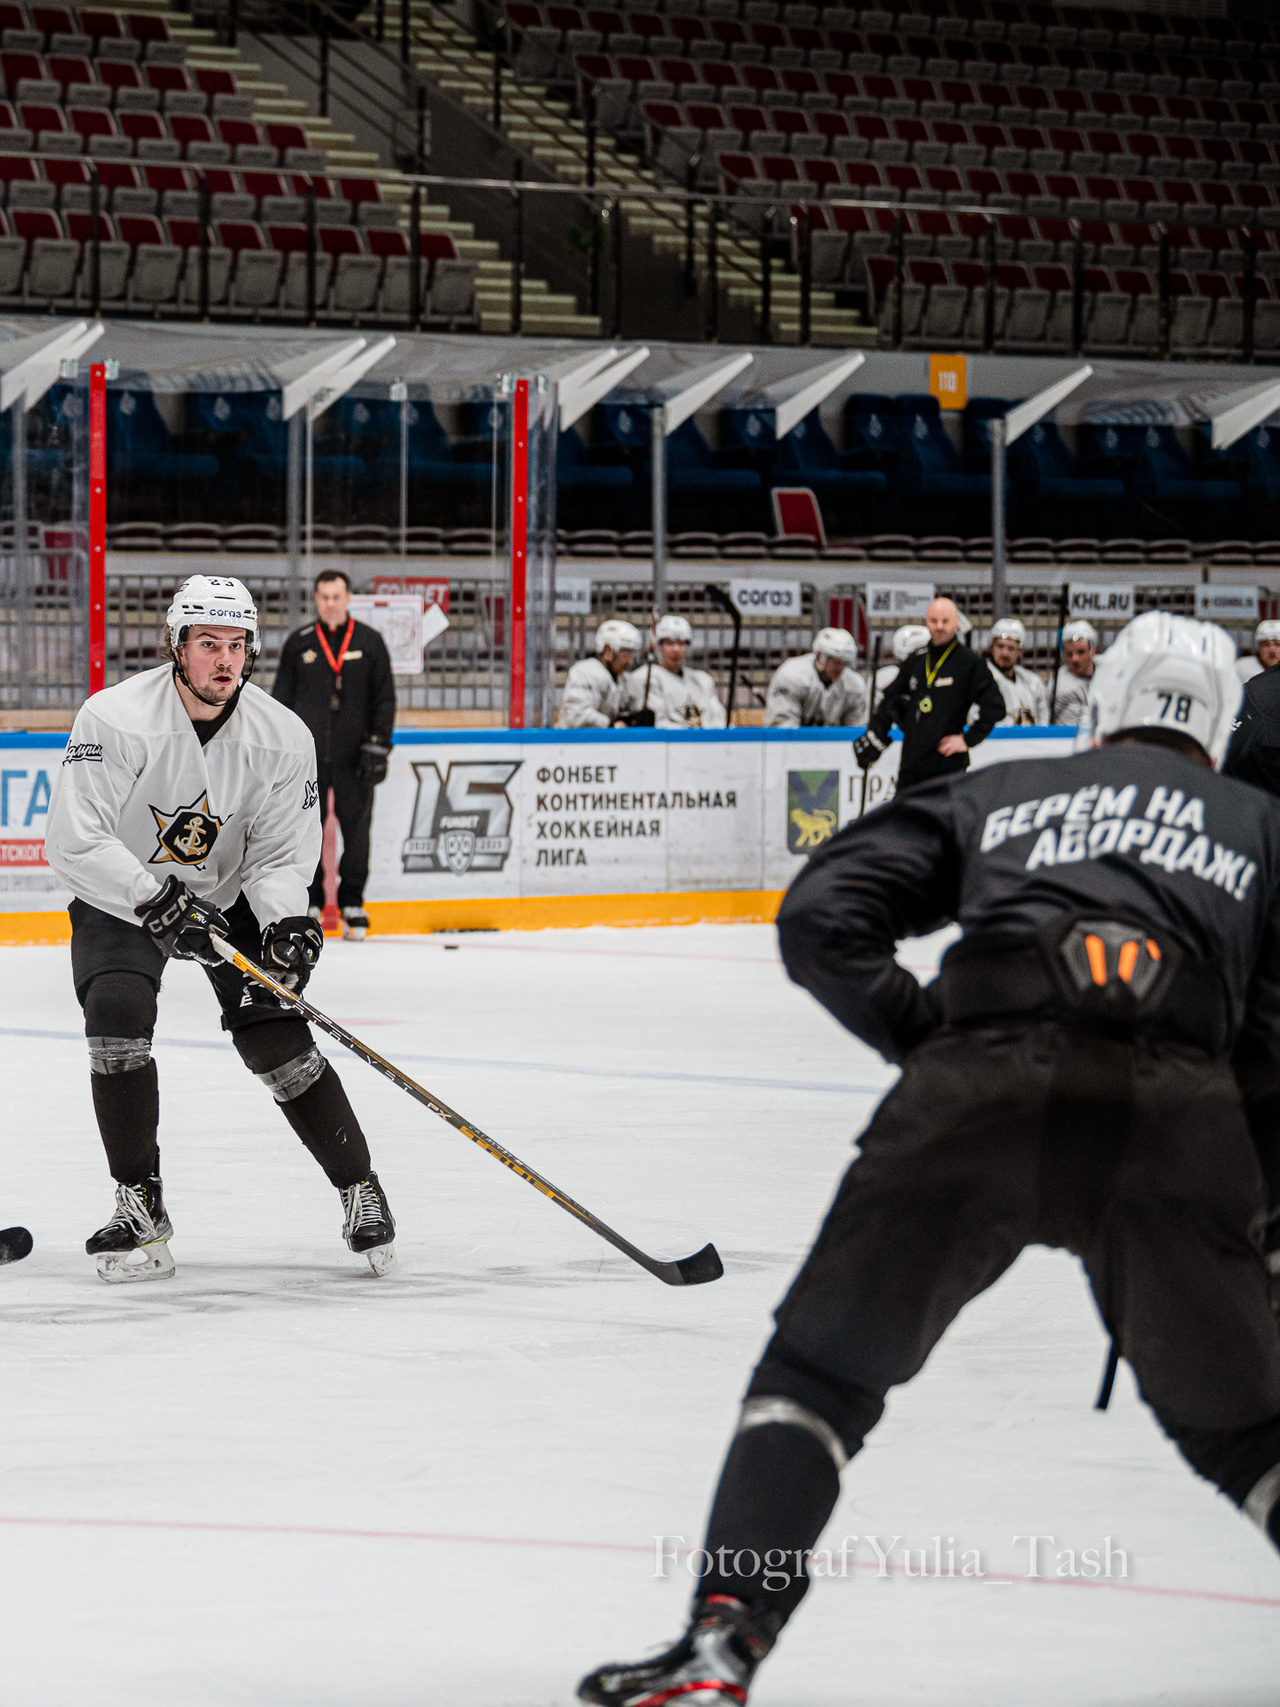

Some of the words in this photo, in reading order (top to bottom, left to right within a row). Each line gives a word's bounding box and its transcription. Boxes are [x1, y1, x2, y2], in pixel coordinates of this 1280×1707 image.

[1072, 592, 1130, 610] KHL.RU
[209, 609, 242, 618] согаз
[1157, 692, 1192, 723] 78
[536, 765, 618, 784] ФОНБЕТ
[848, 775, 897, 802] ПРА
[536, 791, 738, 812] КОНТИНЕНТАЛЬНАЯ
[536, 818, 661, 840] ХОККЕЙНАЯ
[980, 783, 1139, 853] БЕРЁМ
[1144, 785, 1205, 833] НА
[536, 849, 588, 867] ЛИГА
[1025, 818, 1257, 901] АБОРДАЖ!
[147, 887, 194, 934] CCM
